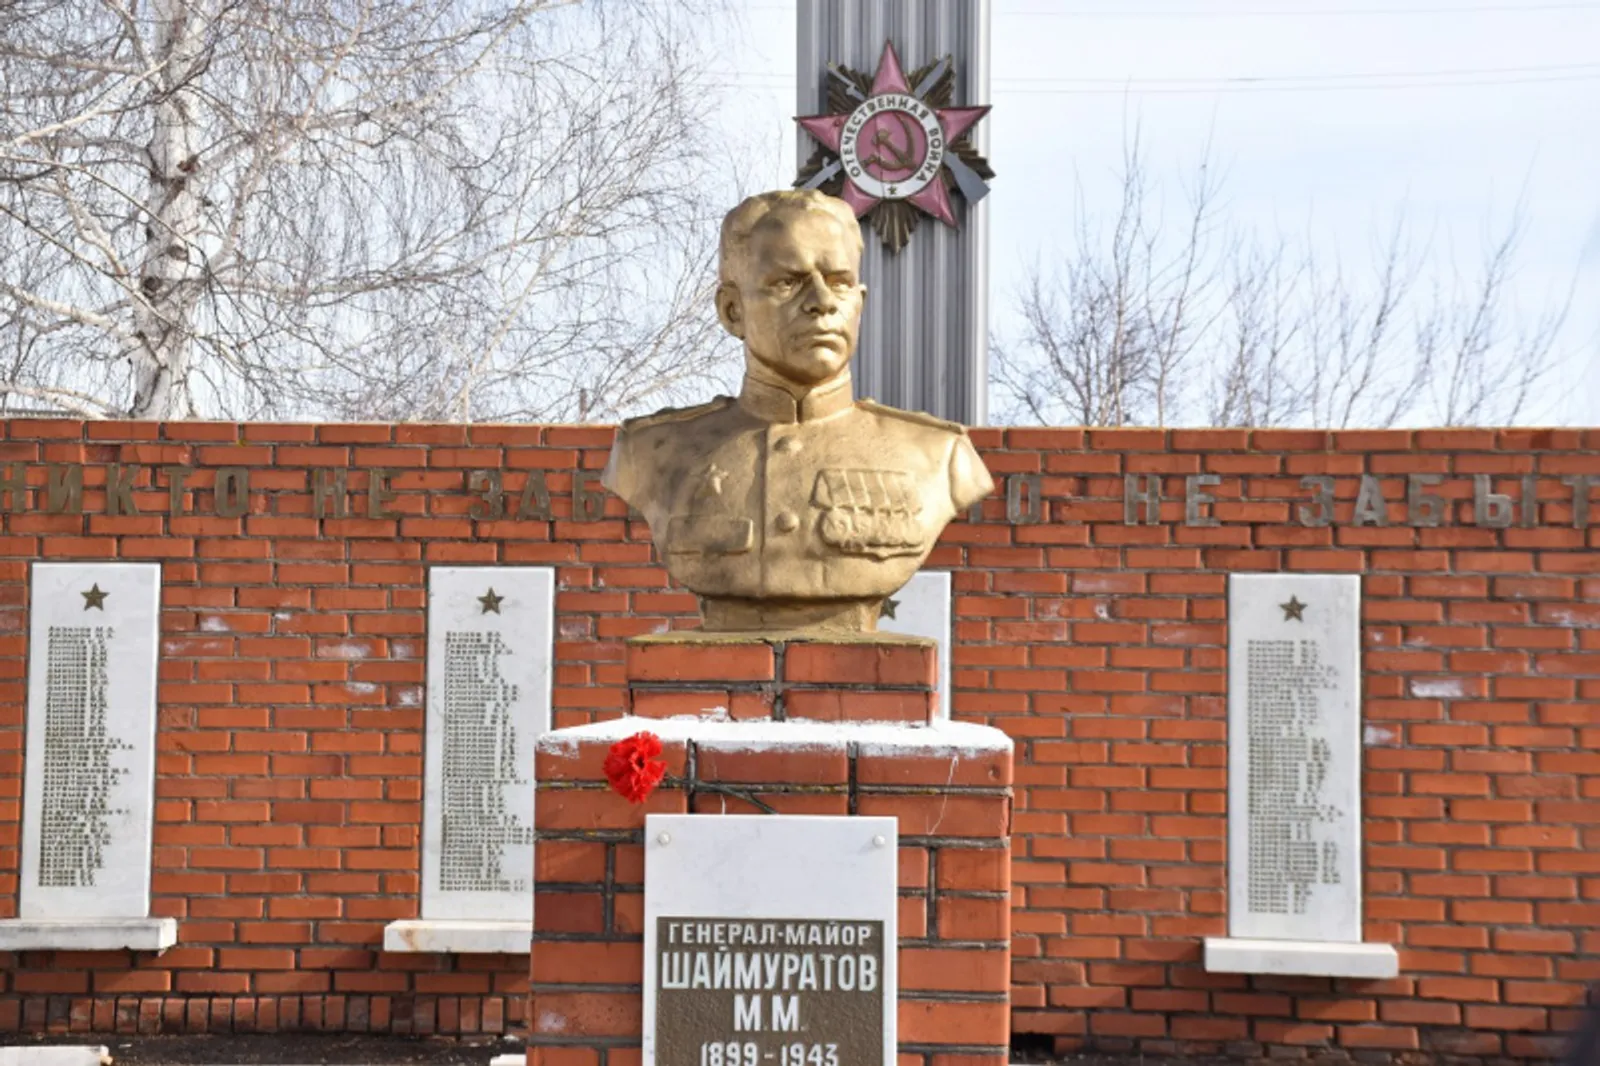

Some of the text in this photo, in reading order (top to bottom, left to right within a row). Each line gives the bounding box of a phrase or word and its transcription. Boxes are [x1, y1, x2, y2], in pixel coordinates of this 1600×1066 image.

[843, 95, 942, 181] ОТЕЧЕСТВЕННАЯ ВОЙНА
[0, 463, 248, 517] НИКТО
[313, 467, 403, 519] НЕ
[469, 469, 648, 521] ЗАБ
[1124, 473, 1221, 527] НЕ
[1300, 473, 1600, 528] ЗАБЫТ
[661, 947, 877, 991] ШАЙМУРАТОВ
